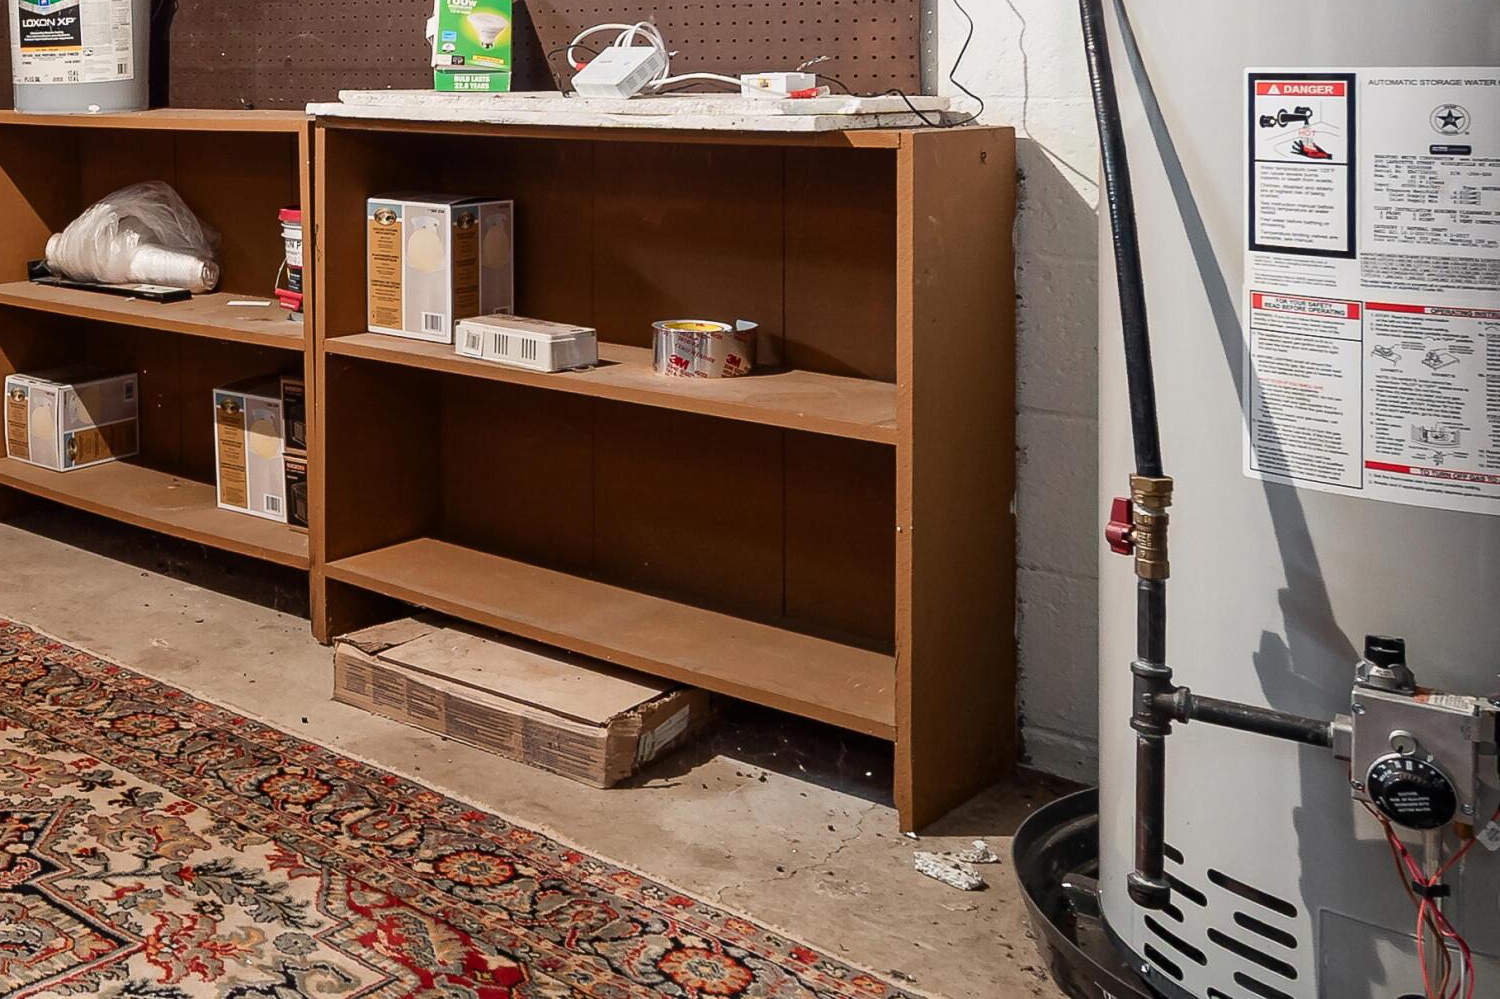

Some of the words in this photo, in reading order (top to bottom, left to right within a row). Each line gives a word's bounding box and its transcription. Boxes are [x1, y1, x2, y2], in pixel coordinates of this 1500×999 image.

[22, 18, 55, 28] LOXON
[1463, 79, 1497, 87] WATER
[1284, 85, 1334, 95] DANGER
[1299, 129, 1316, 137] HOT
[1308, 301, 1333, 309] SAFETY
[1308, 306, 1345, 316] OPERATING
[669, 354, 690, 370] 3M
[726, 353, 742, 368] 3M
